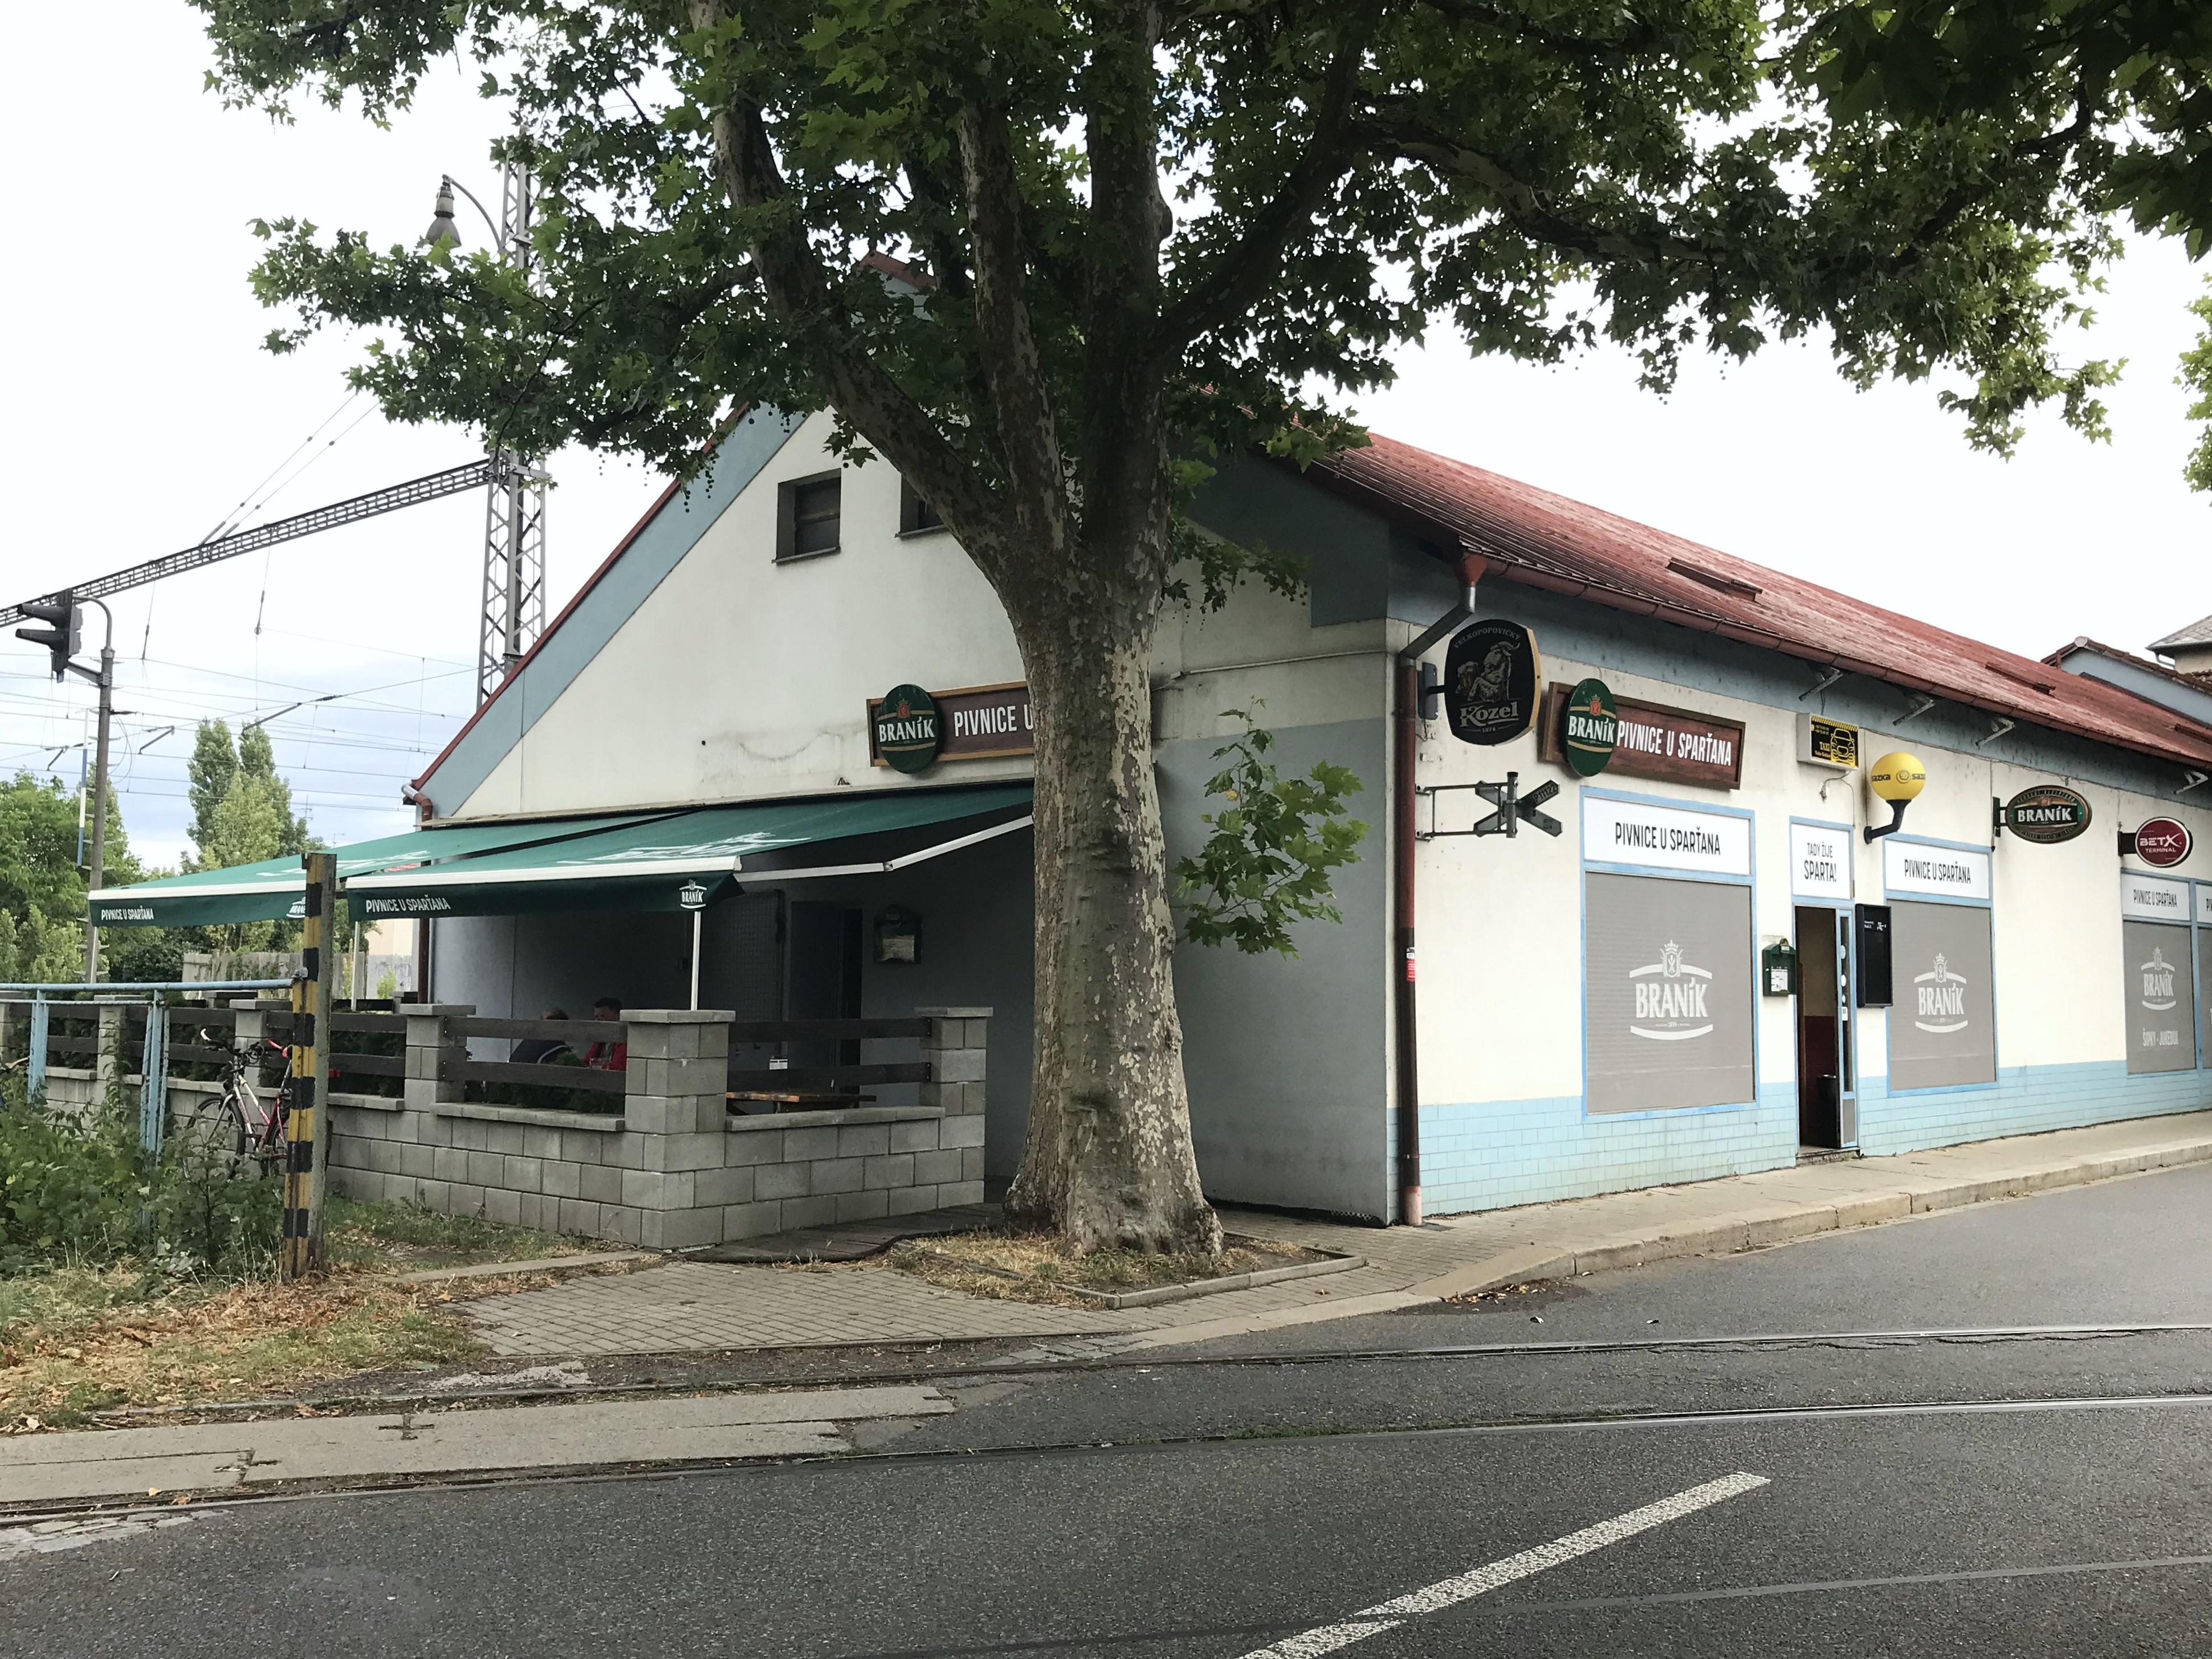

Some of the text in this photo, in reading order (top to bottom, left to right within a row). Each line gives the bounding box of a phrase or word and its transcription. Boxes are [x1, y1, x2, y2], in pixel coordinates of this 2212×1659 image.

[954, 704, 1034, 737] PIVNICE U
[1459, 701, 1519, 727] Kozel
[1616, 720, 1732, 767] PIVNICE U SPARŤANA
[1615, 822, 1721, 855] PIVNICE U SPARŤANA
[1807, 841, 1833, 858] TADY ŽIJE
[1804, 860, 1836, 882] SPARTA!
[1905, 859, 1971, 884] PIVNICE U SPARŤANA
[365, 894, 451, 912] PIVNICE U SPARŤANA
[2133, 889, 2151, 905] PIVNICE
[2152, 891, 2155, 906] U
[101, 909, 123, 920] PIVNICE
[123, 908, 128, 920] U
